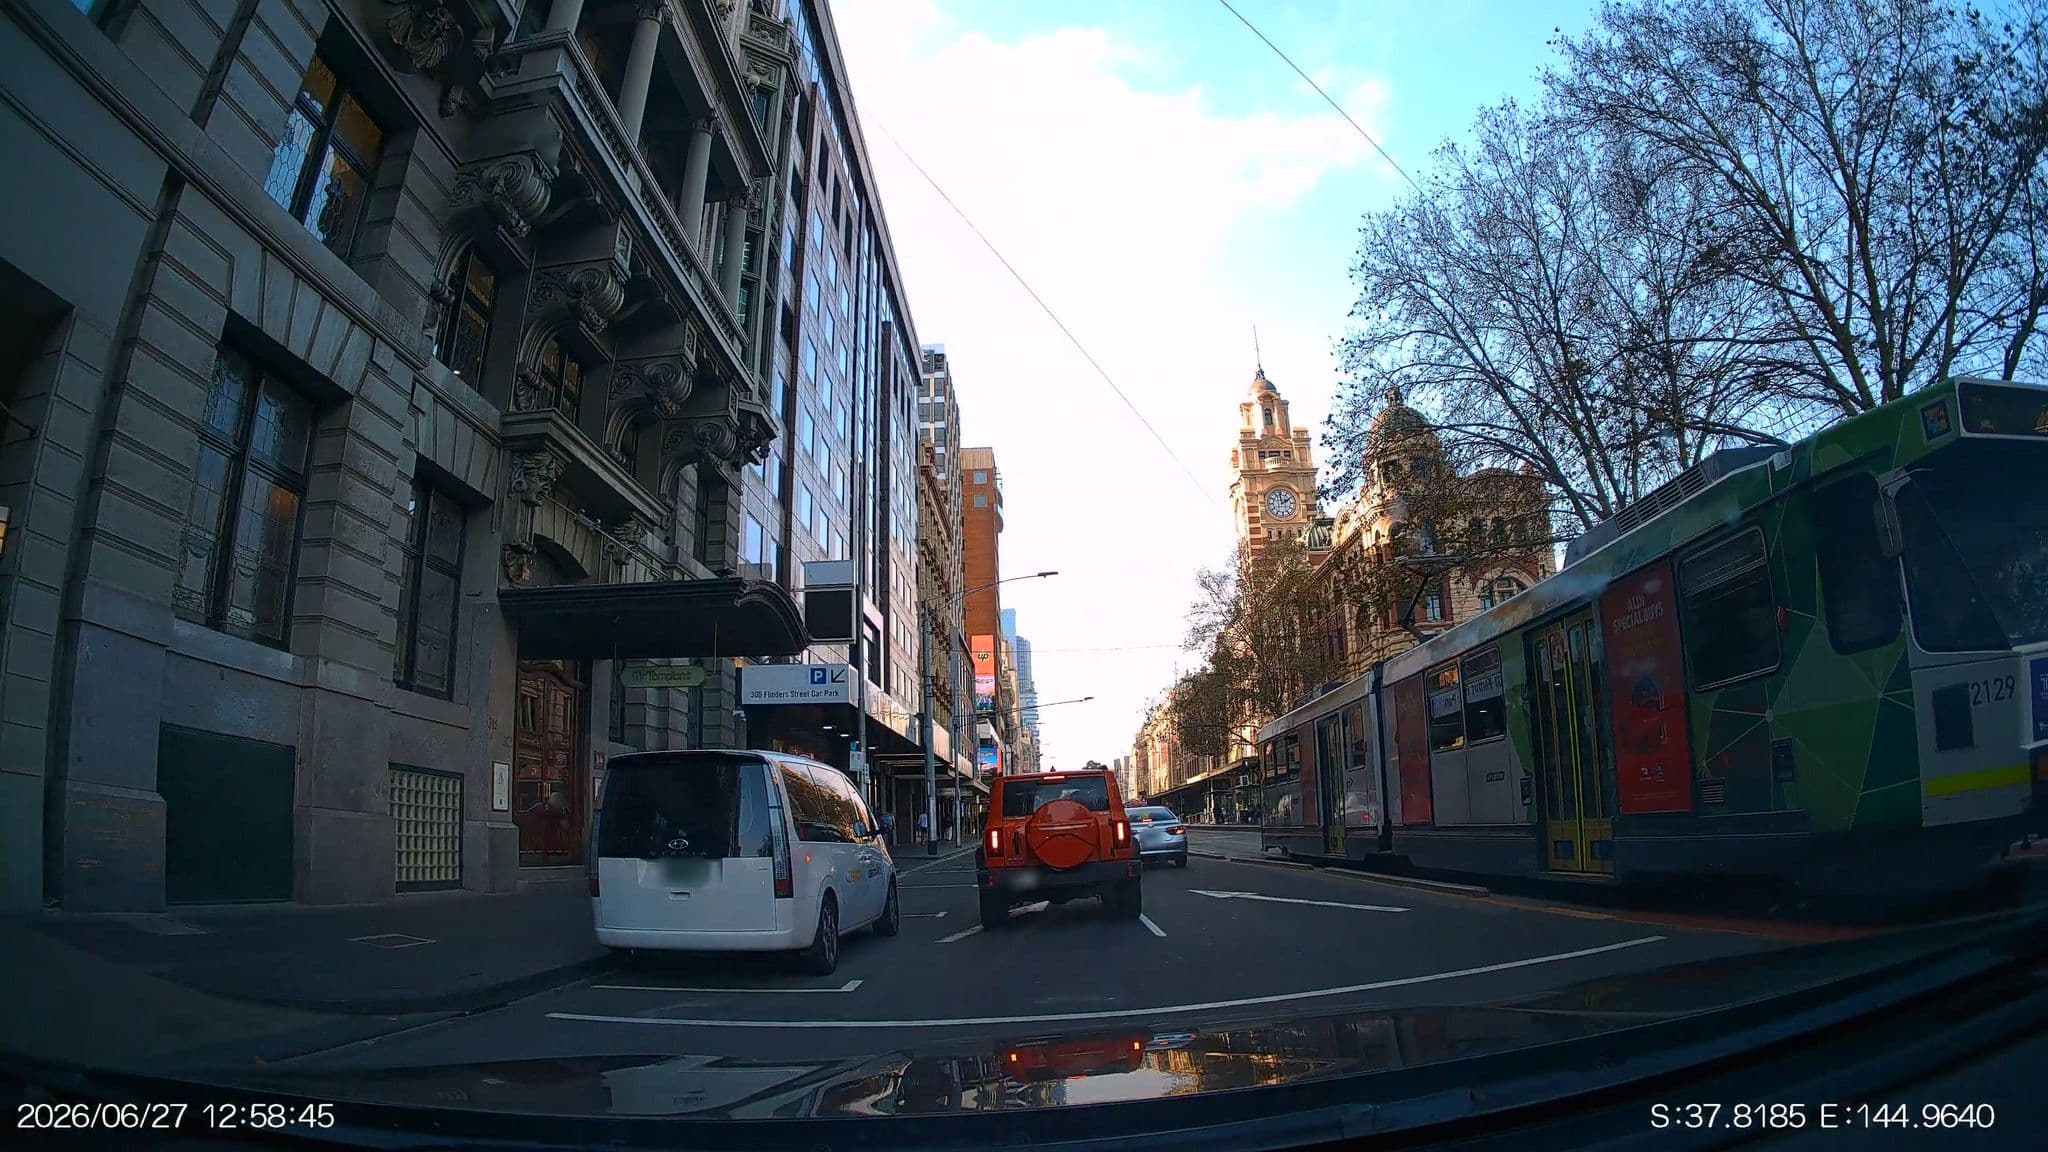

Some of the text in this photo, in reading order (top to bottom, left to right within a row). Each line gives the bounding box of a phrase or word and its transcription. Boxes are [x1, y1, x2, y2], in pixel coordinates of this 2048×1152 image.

[1626, 593, 1645, 612] ALDI
[978, 653, 988, 662] up
[751, 689, 839, 698] 300 Flinders Street Car Park
[1971, 675, 2016, 705] 2129
